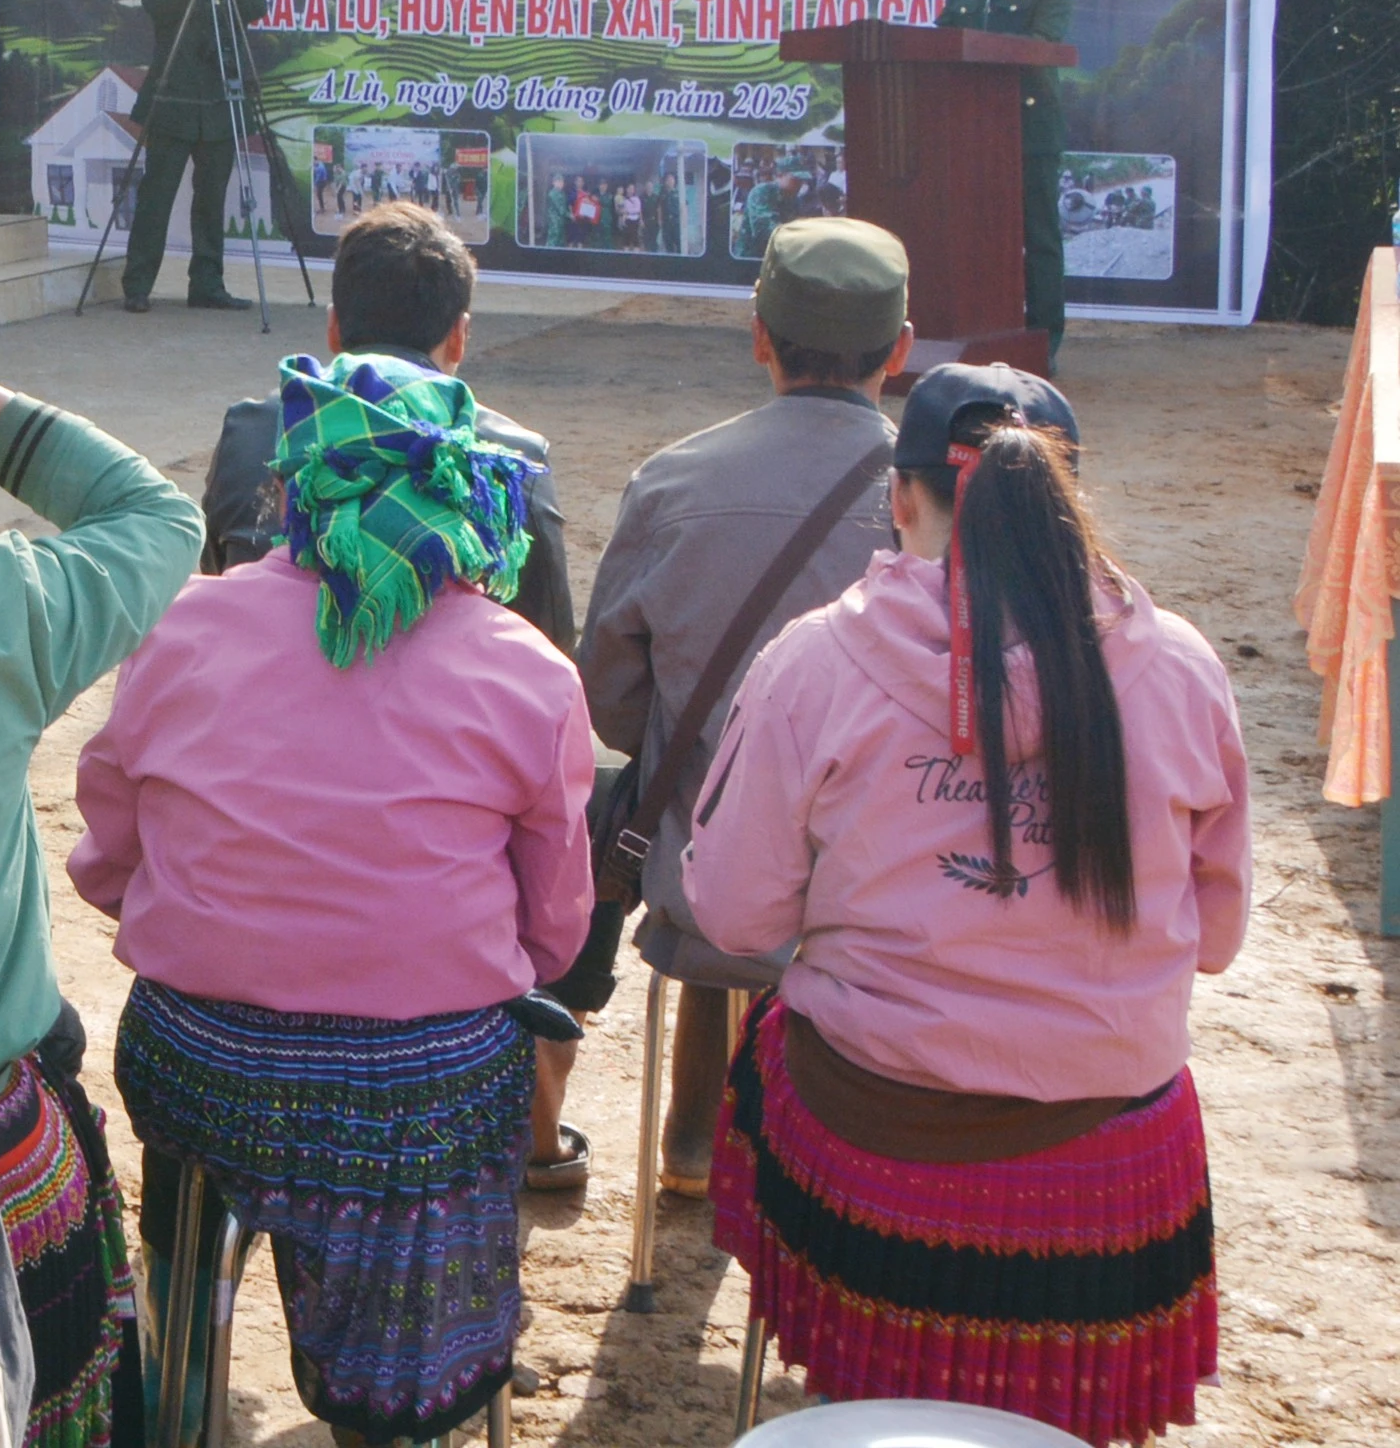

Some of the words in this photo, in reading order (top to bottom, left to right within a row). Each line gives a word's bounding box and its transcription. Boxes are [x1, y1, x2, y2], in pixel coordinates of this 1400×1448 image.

[311, 69, 338, 102] A
[341, 70, 390, 109] Lù,
[397, 73, 466, 112] ngày
[472, 76, 508, 108] 03
[515, 77, 604, 118] tháng
[609, 78, 645, 112] 01
[652, 83, 724, 115] năm
[730, 83, 809, 119] 2025
[955, 655, 971, 739] Supreme
